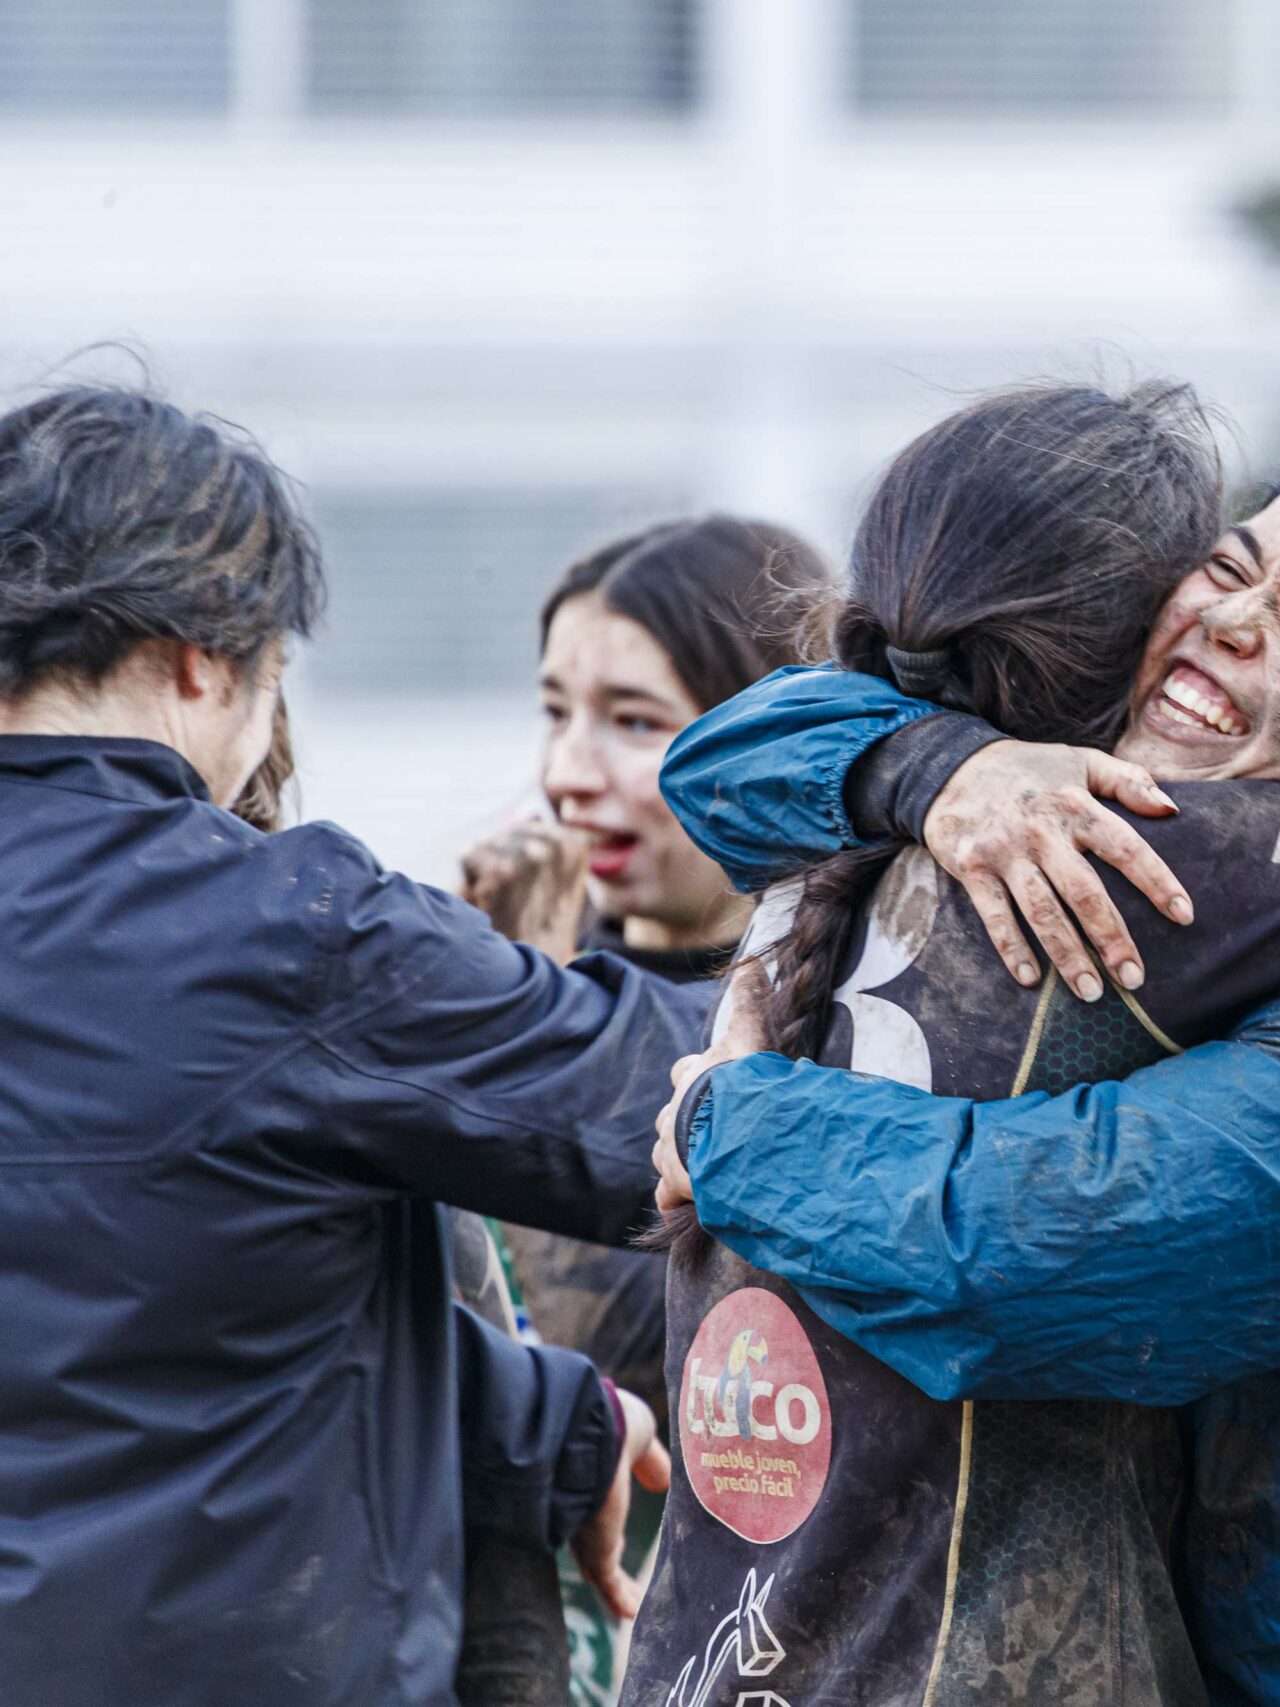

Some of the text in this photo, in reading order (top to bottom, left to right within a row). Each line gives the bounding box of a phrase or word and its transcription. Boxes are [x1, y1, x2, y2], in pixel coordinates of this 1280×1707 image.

[686, 1358, 822, 1446] tuco
[700, 1449, 802, 1479] mueble joven,
[712, 1472, 795, 1498] precio fácil
